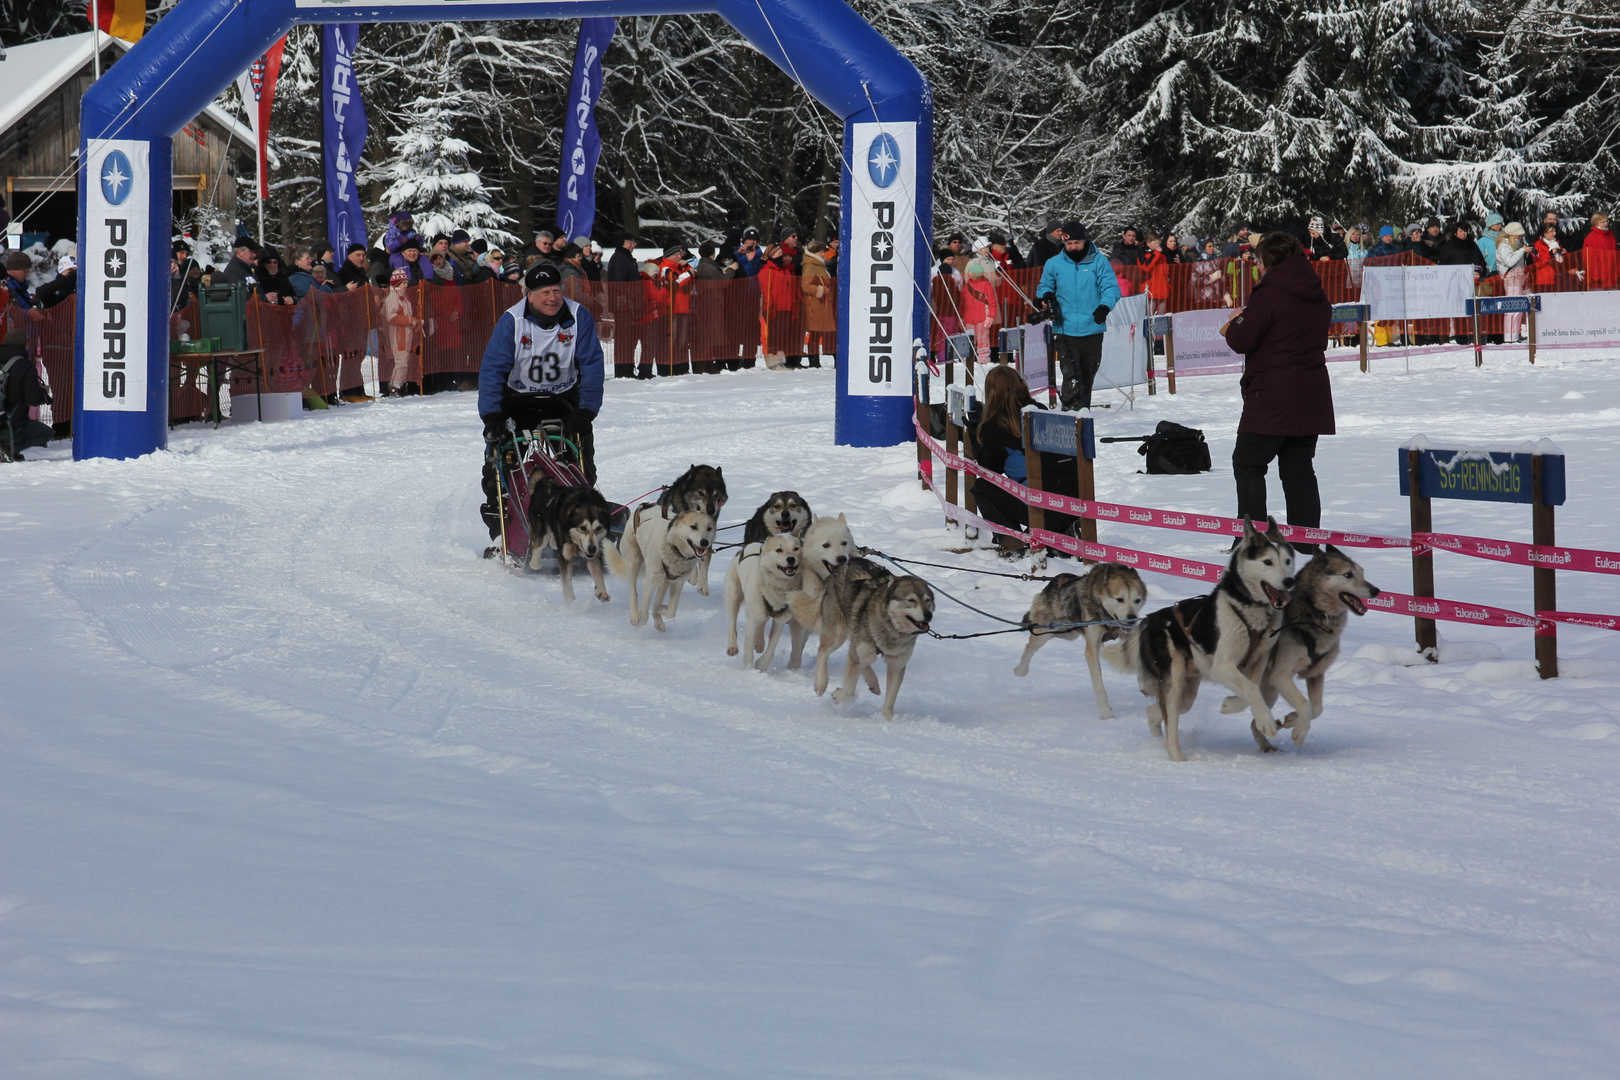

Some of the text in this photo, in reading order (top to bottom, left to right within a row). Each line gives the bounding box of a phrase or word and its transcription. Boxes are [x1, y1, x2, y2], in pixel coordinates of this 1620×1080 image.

[869, 201, 895, 384] POLARIS
[102, 219, 127, 400] POLARIS
[528, 351, 561, 383] 63
[1097, 506, 1116, 518] Eukanuba
[1129, 511, 1149, 521] Eukanuba
[1163, 515, 1183, 526] Eukanuba
[1197, 518, 1217, 530] Eukanuba
[1305, 529, 1328, 540] Eukanuba
[1116, 552, 1136, 563] Eukanuba
[1149, 558, 1169, 570] Eukanuba
[1182, 564, 1203, 576] Eukanuba
[1477, 543, 1506, 556] Eukanuba
[1528, 549, 1565, 564] Eukanuba
[1408, 600, 1435, 614] Eukanuba
[1455, 606, 1484, 620] Eukanuba
